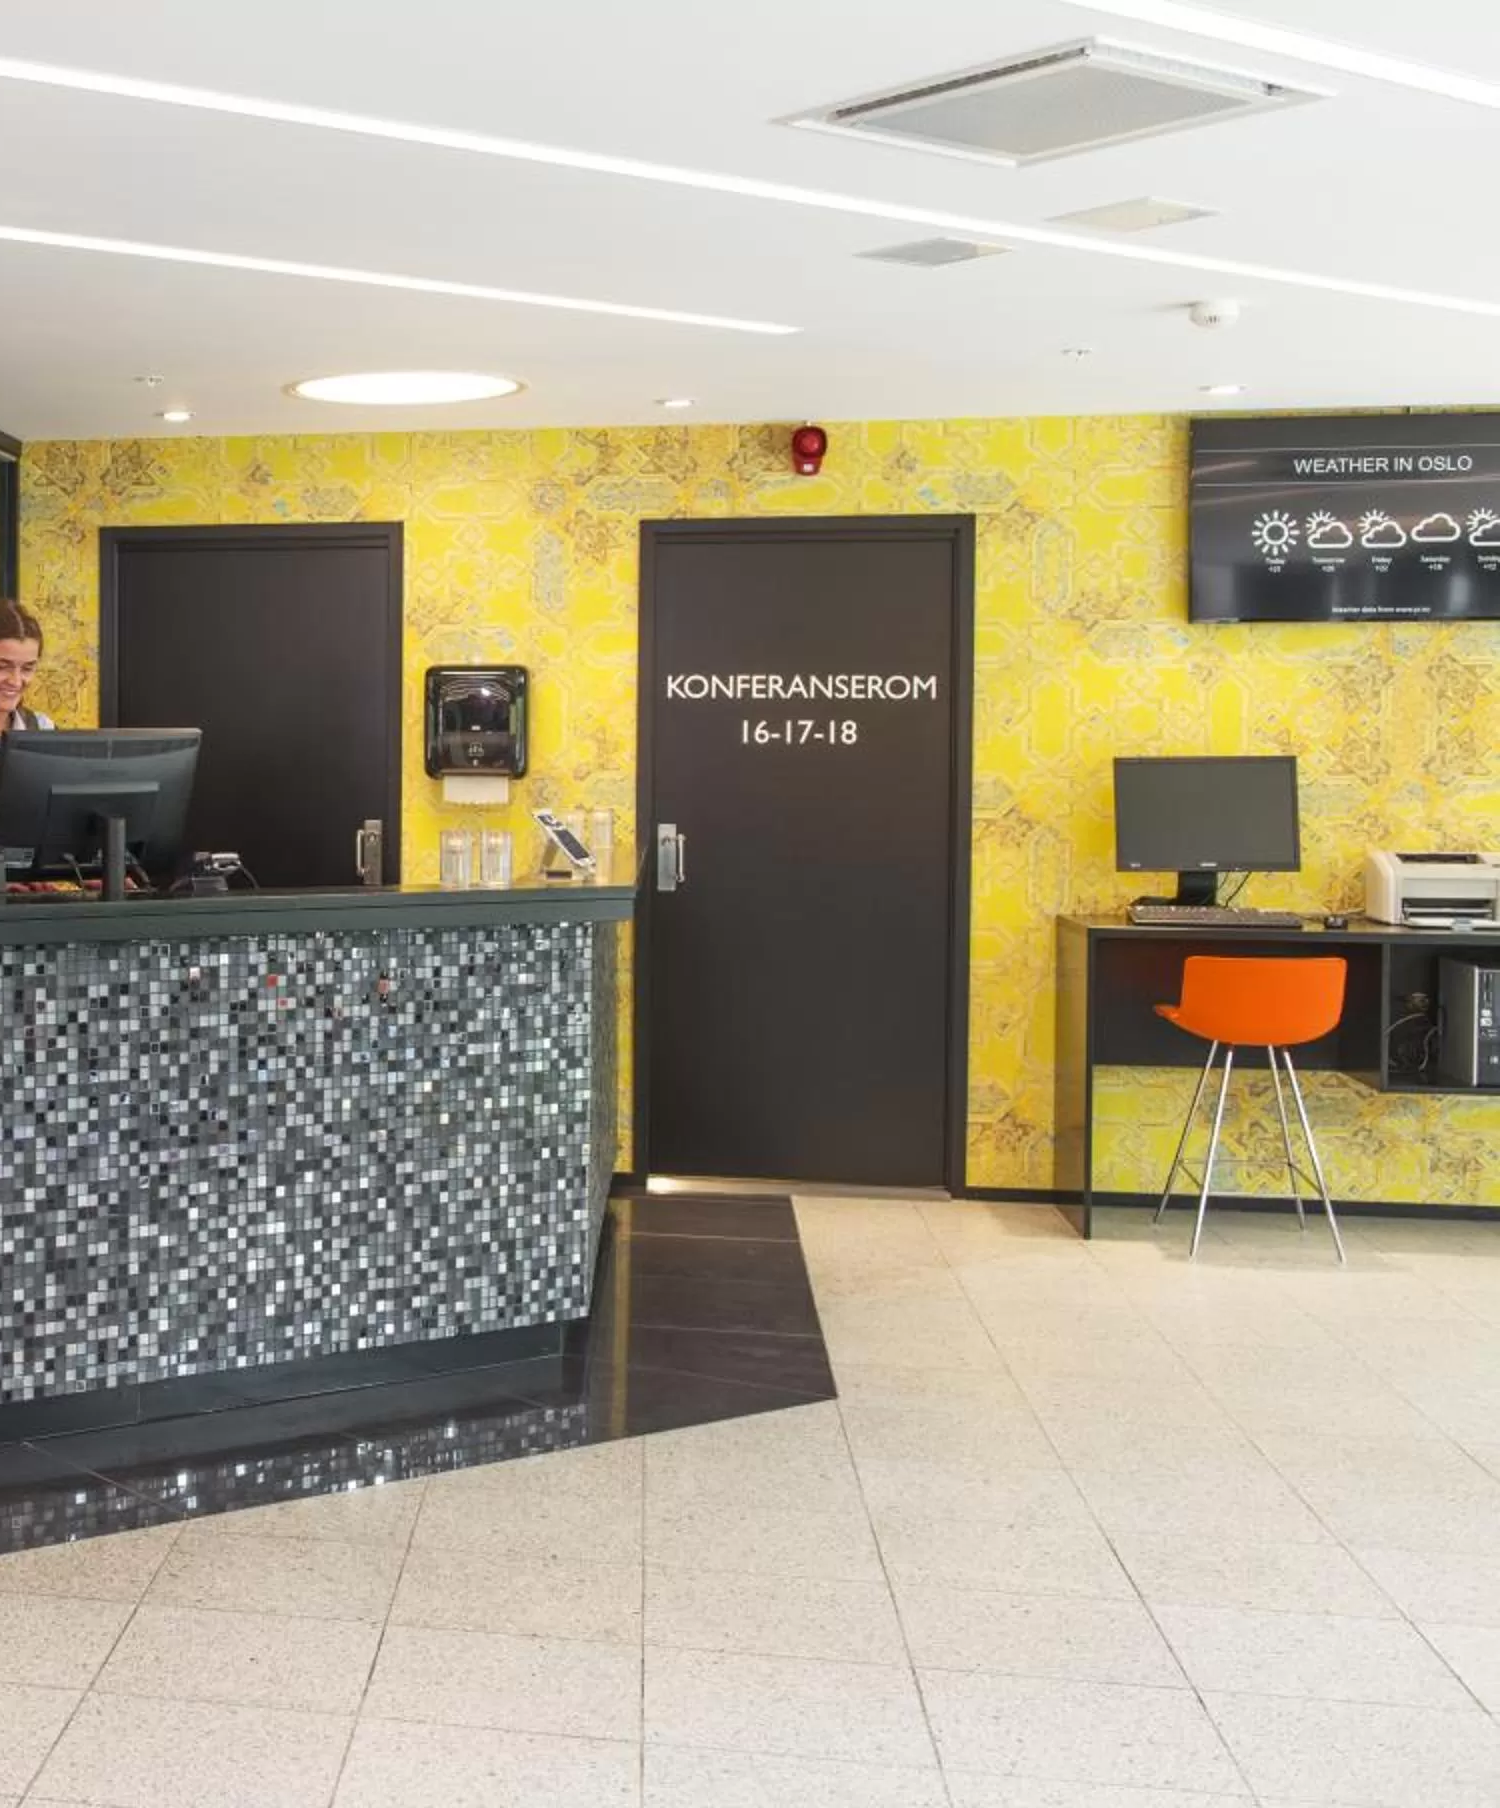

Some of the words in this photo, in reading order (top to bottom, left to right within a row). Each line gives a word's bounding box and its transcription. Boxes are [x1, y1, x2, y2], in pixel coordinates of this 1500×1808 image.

[1293, 456, 1389, 475] WEATHER
[1394, 455, 1413, 472] IN
[1418, 454, 1473, 472] OSLO
[666, 673, 938, 700] KONFERANSEROM
[742, 719, 858, 745] 16-17-18
